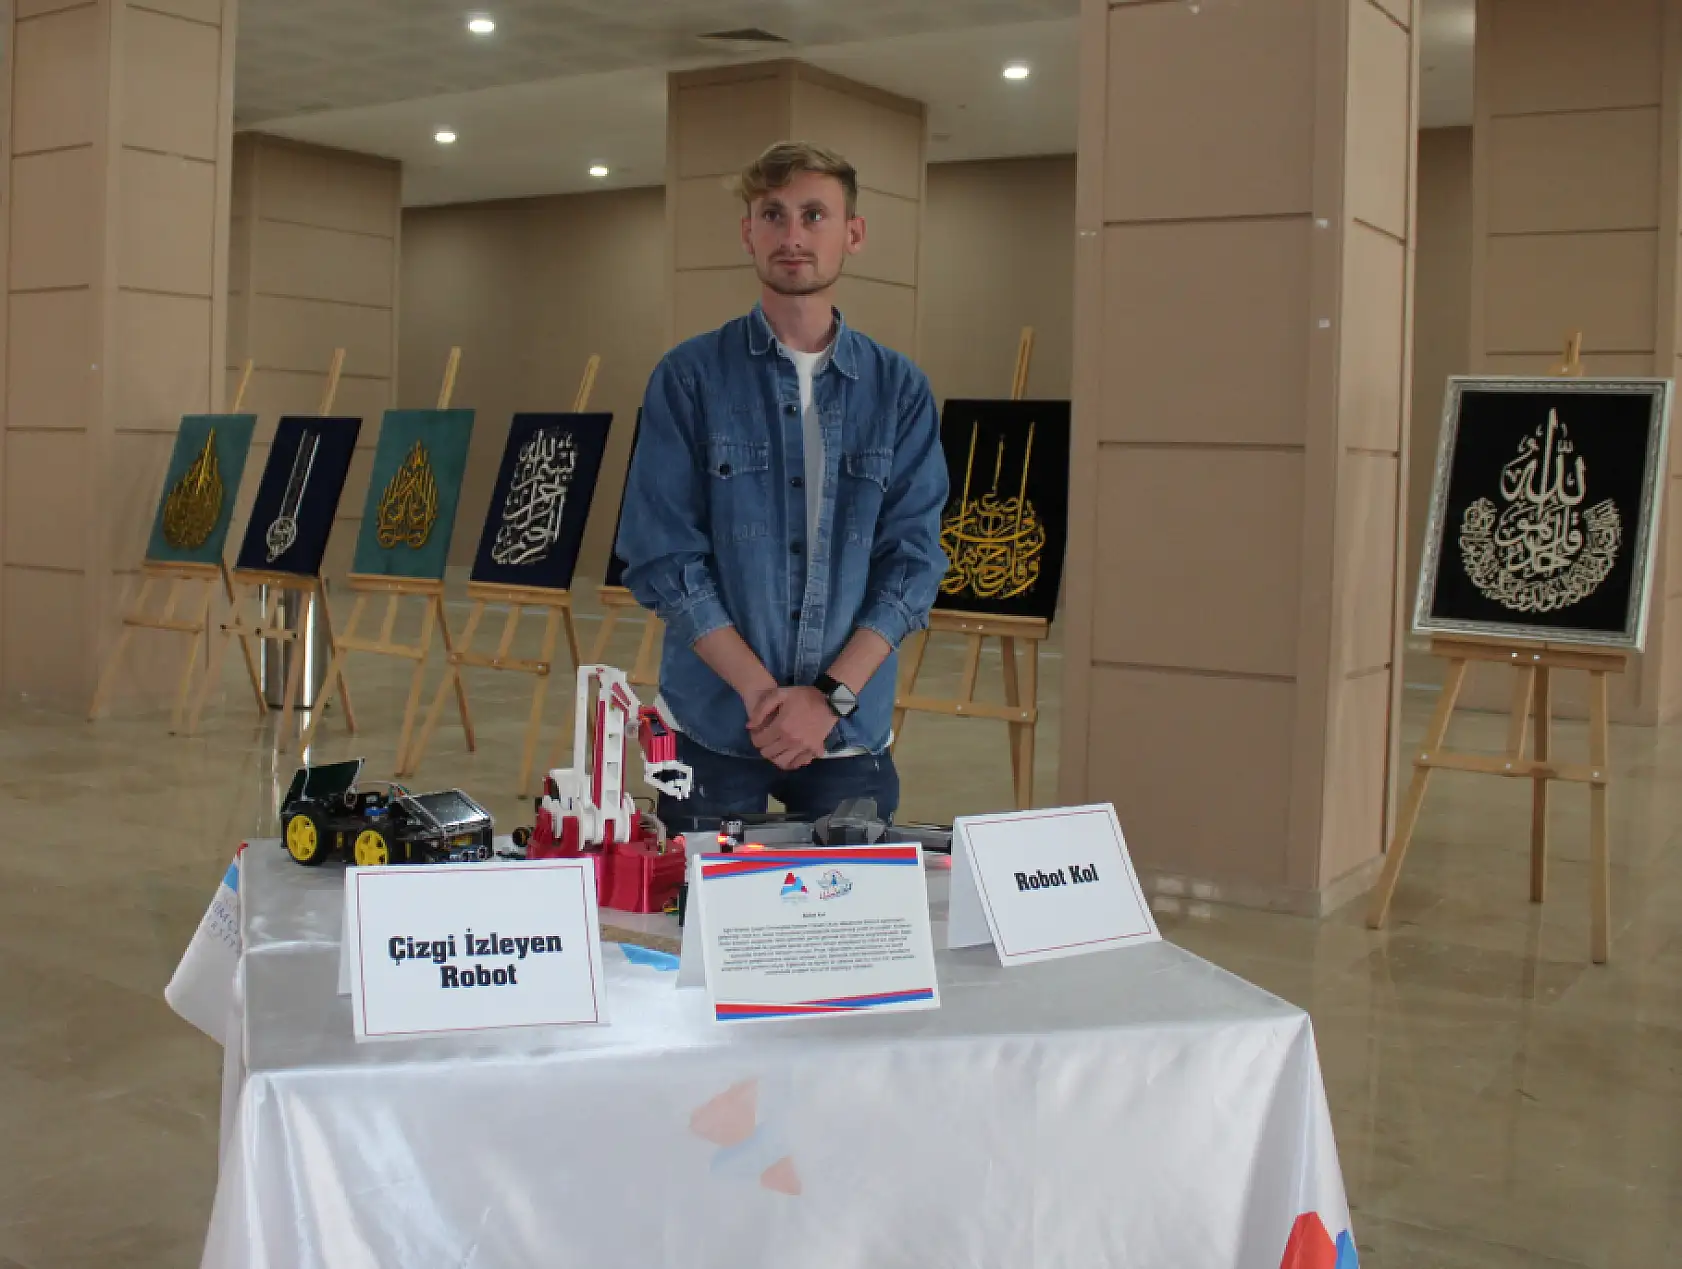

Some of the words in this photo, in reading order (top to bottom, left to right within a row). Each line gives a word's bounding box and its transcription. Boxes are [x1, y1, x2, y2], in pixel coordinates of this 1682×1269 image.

[1013, 868, 1067, 891] Robot
[1067, 863, 1100, 885] Kol
[388, 934, 457, 966] Çizgi
[464, 928, 563, 960] İzleyen
[440, 963, 518, 989] Robot
